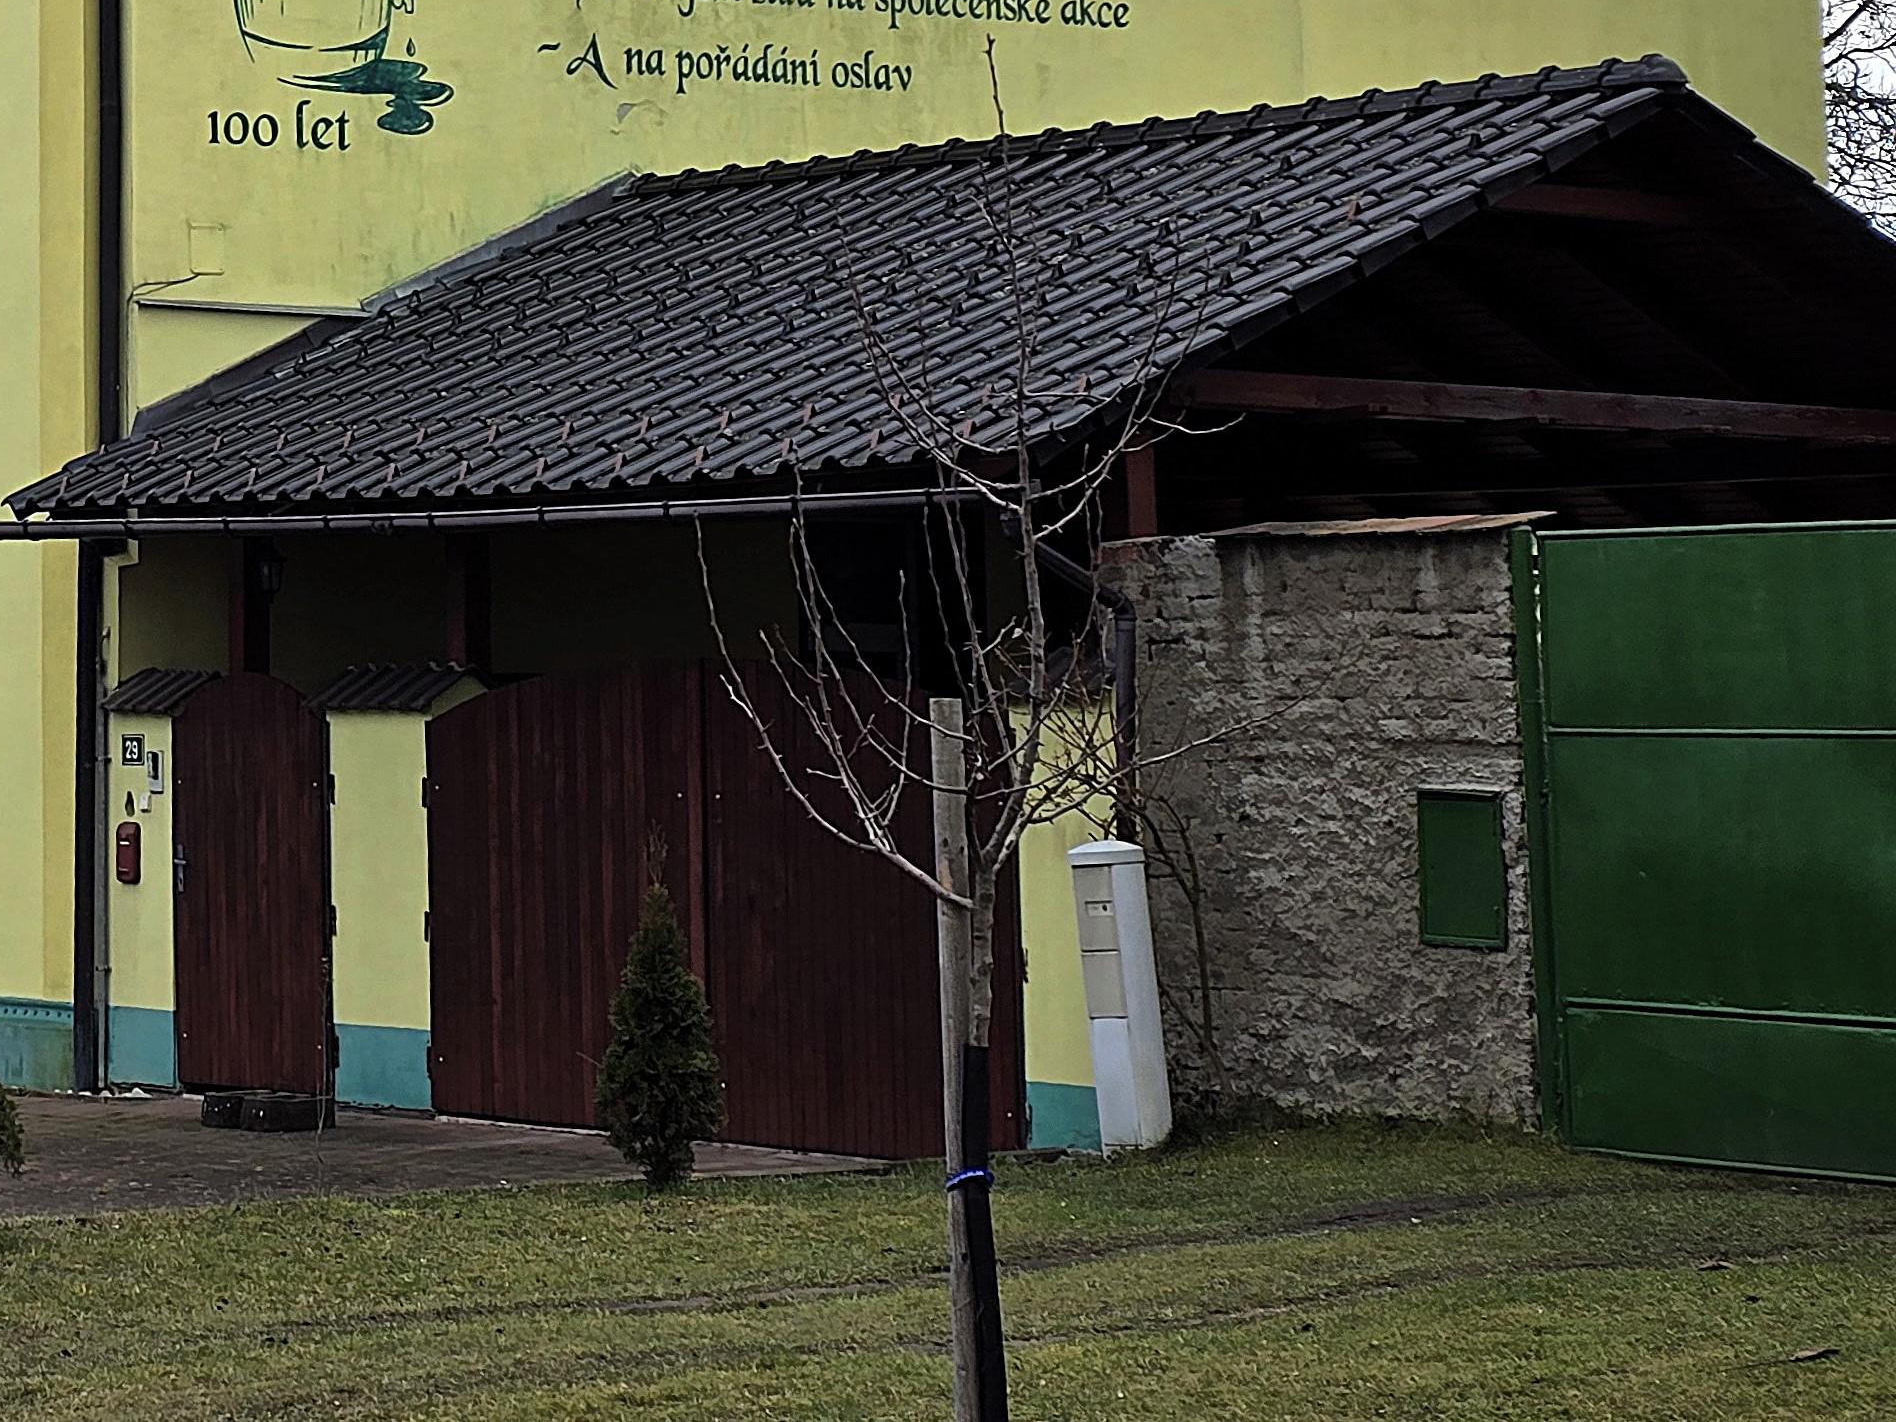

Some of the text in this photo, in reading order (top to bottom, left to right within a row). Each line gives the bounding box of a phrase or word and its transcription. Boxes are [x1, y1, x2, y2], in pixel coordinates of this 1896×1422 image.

[624, 47, 666, 76] na
[675, 44, 821, 95] pořádání
[832, 50, 913, 91] oslav
[208, 99, 351, 151] 100 let
[124, 740, 139, 760] 29
